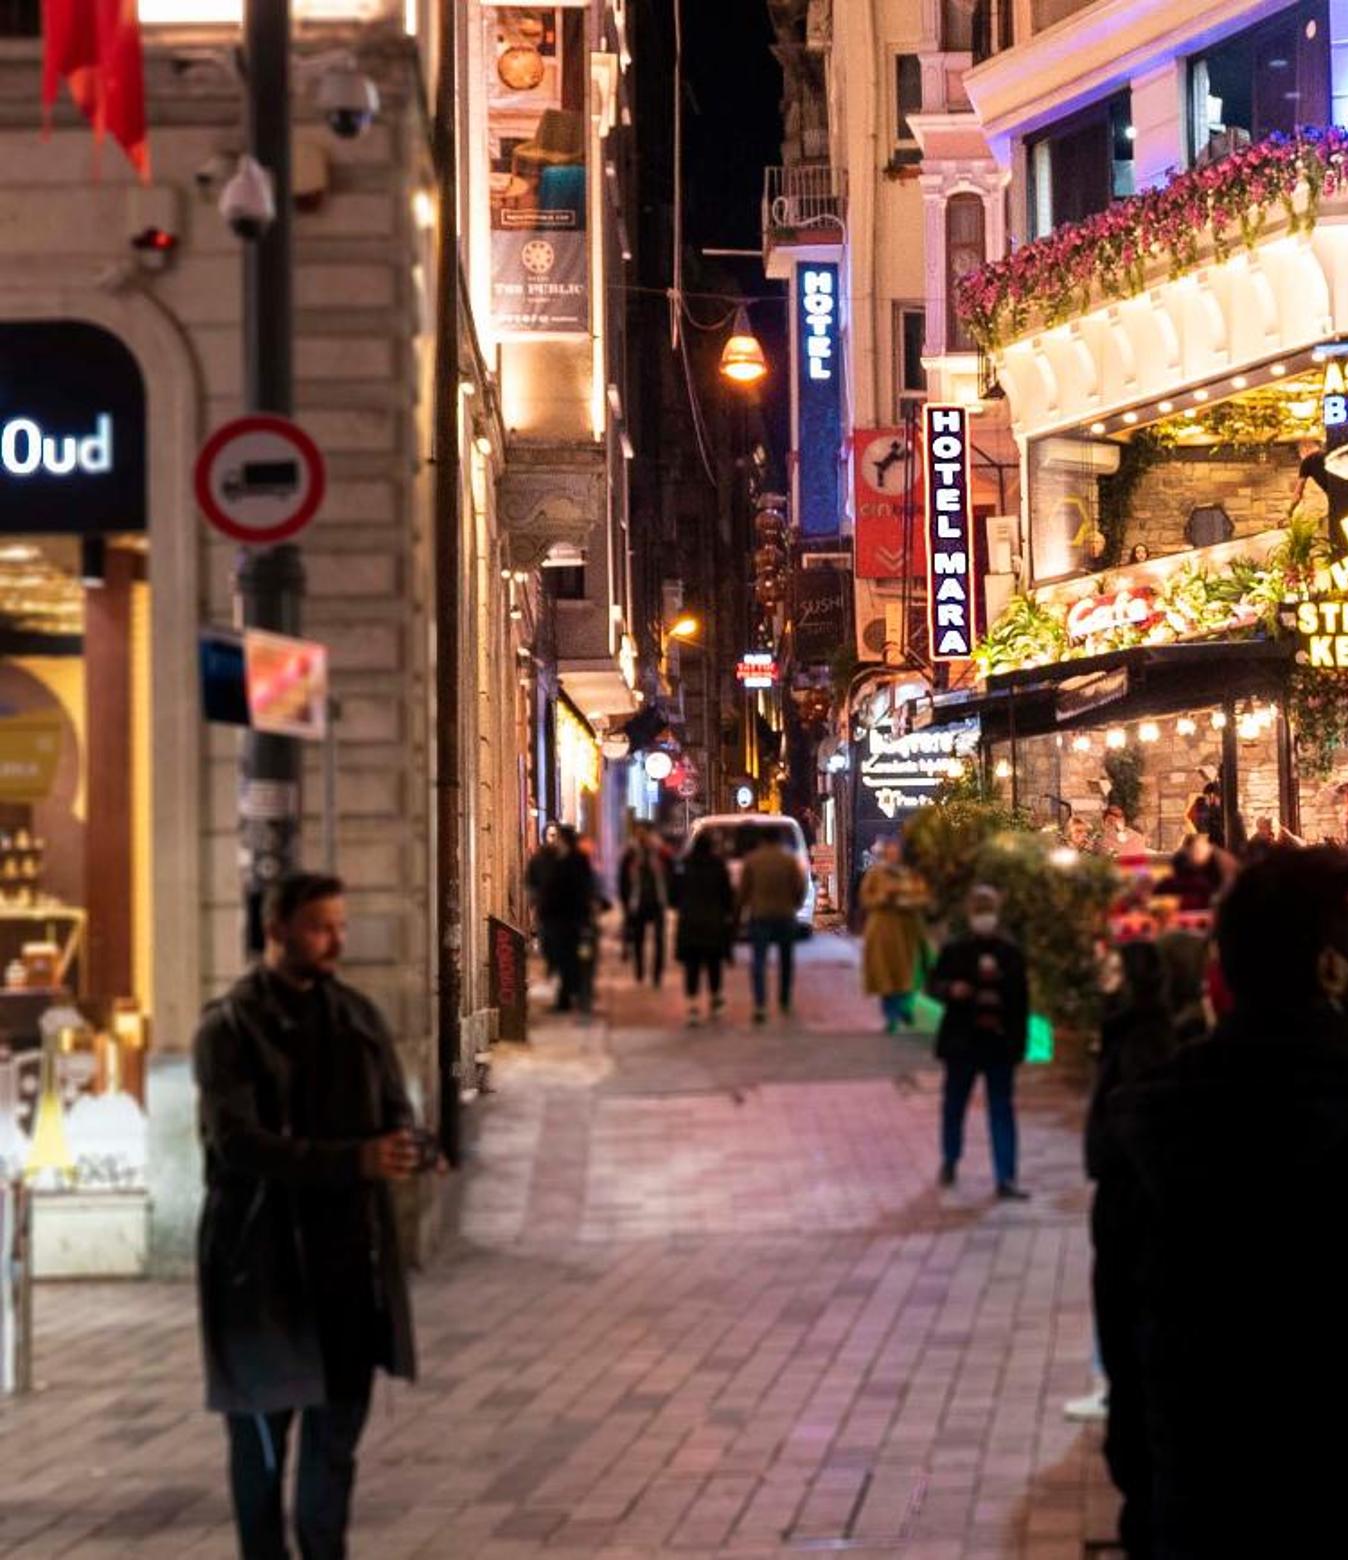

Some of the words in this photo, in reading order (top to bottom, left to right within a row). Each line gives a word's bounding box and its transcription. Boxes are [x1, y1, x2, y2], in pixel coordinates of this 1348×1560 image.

[803, 271, 834, 379] HOTEL
[1, 413, 113, 475] Oud
[932, 411, 962, 538] HOTEL
[934, 552, 968, 653] MARA
